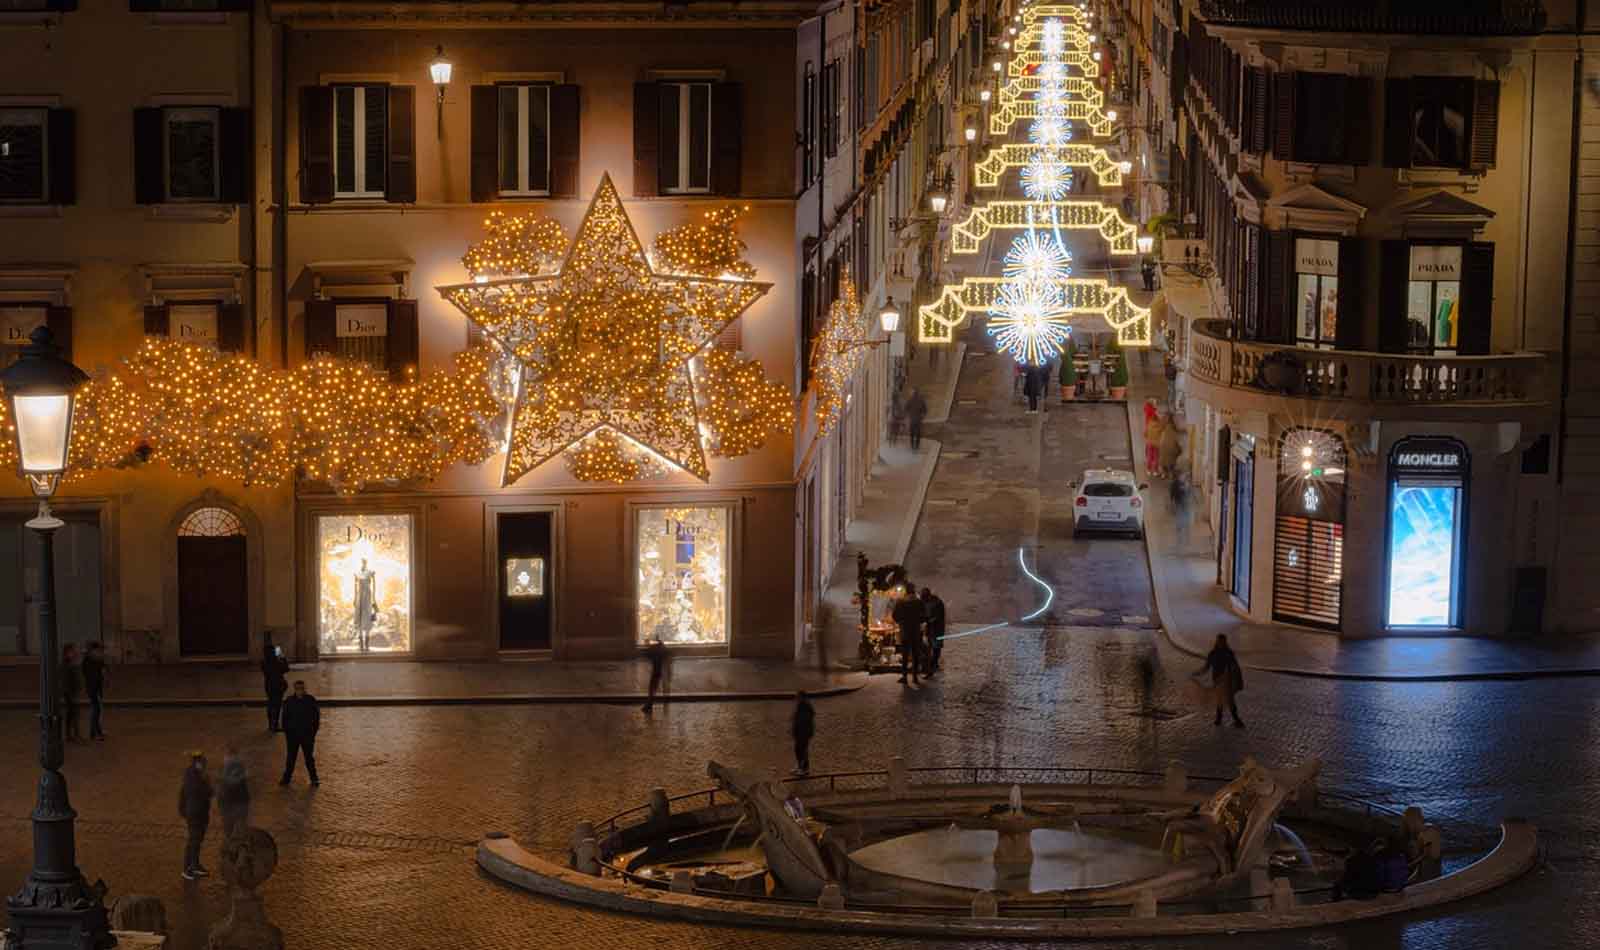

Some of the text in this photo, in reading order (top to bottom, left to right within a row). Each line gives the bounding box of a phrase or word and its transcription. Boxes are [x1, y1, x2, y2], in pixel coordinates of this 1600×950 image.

[1417, 263, 1456, 273] PRADA
[347, 319, 377, 333] Dior
[1398, 454, 1459, 465] MONCLER
[346, 525, 386, 543] Dior
